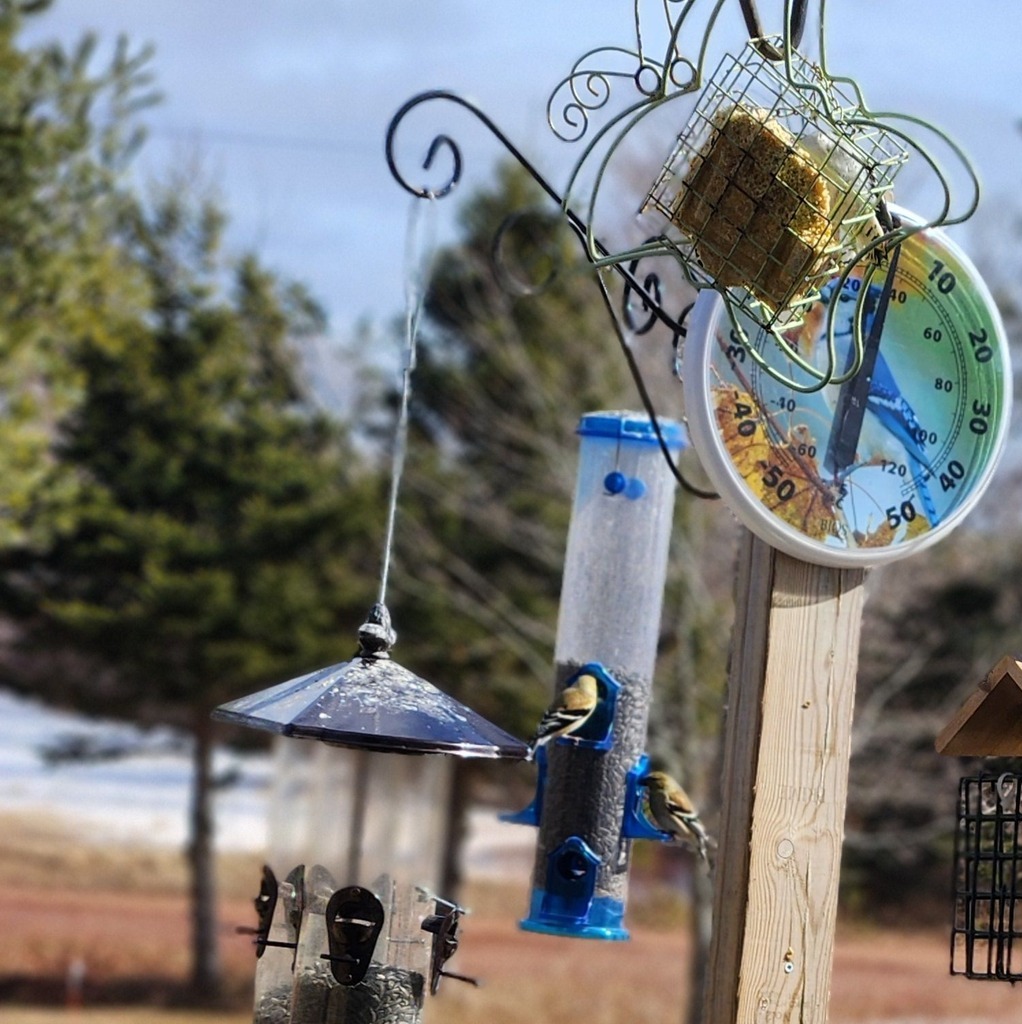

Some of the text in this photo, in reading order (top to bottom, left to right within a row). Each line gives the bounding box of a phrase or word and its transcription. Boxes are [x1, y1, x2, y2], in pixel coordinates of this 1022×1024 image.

[928, 259, 956, 294] 10
[923, 327, 942, 343] 60
[968, 328, 993, 363] 20
[934, 378, 953, 393] 80
[969, 399, 991, 435] 30
[880, 460, 907, 477] 120
[938, 460, 965, 492] 40
[886, 500, 916, 530] 50
